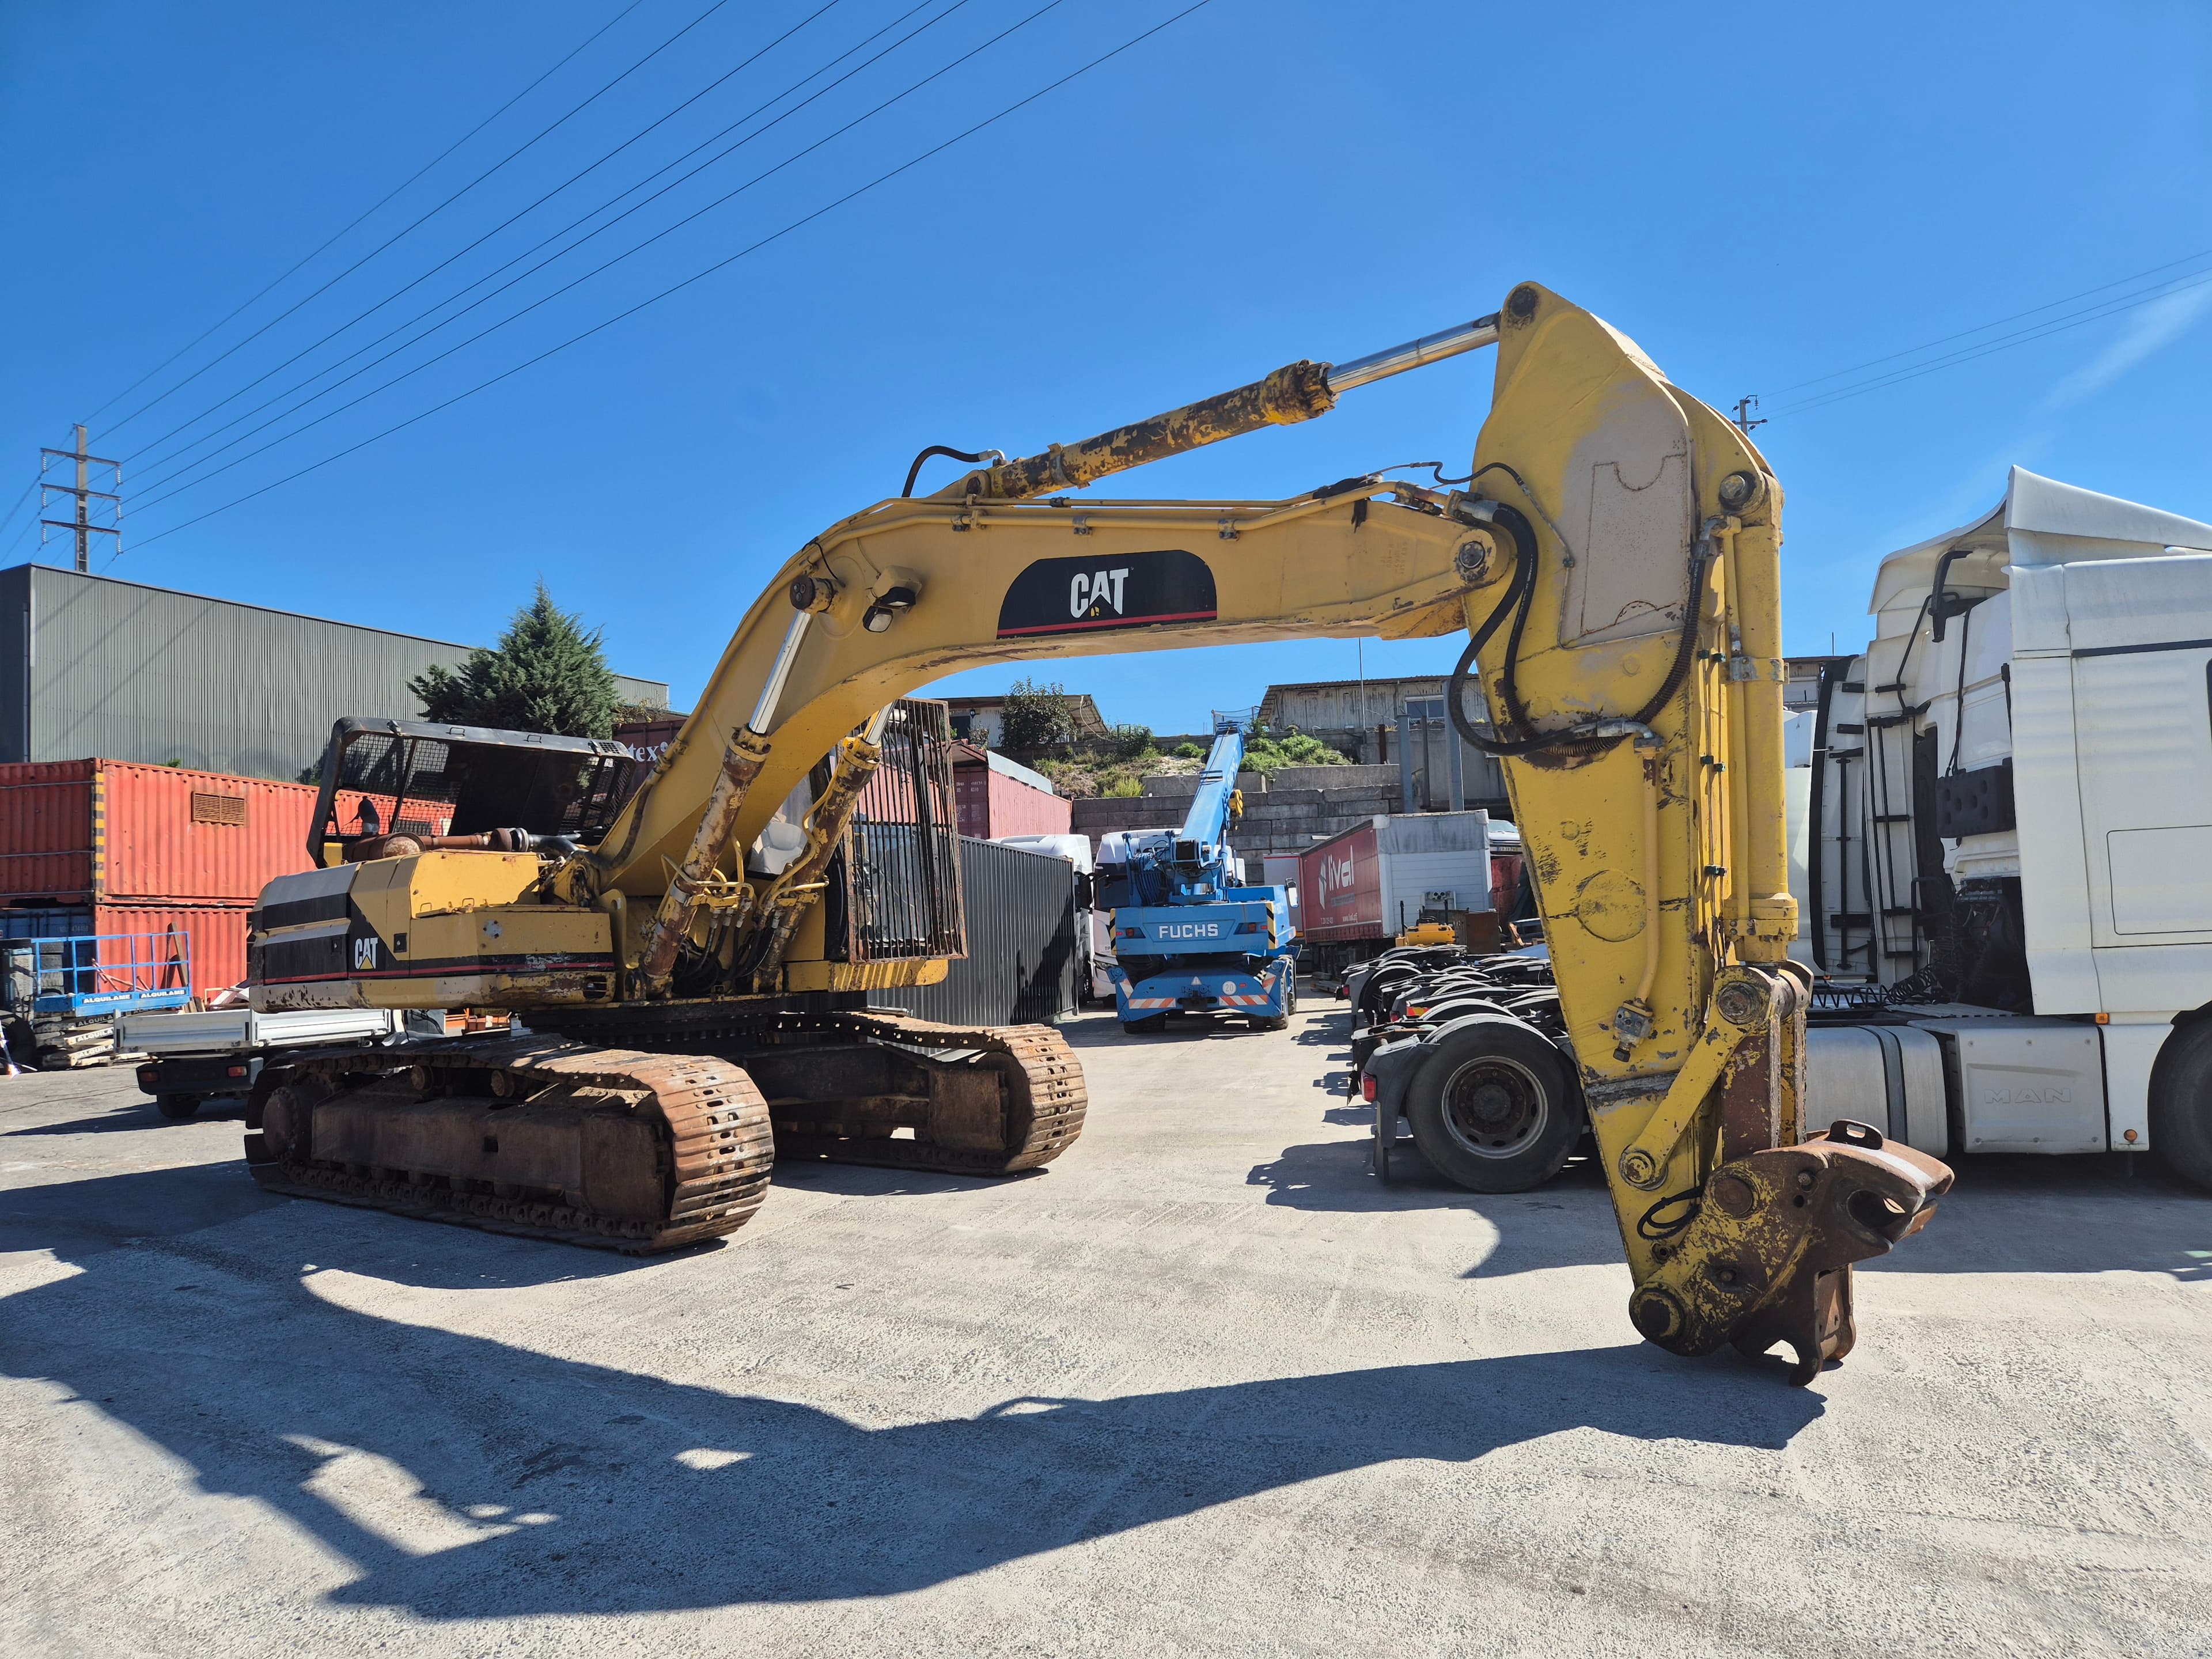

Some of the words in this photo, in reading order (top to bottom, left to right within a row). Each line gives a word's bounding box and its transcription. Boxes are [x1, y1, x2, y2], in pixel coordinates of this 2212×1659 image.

[1070, 568, 1129, 618] CAT
[1328, 844, 1355, 892] lival
[1158, 923, 1219, 939] FUCHS
[355, 937, 378, 969] CAT
[141, 990, 185, 998] ALQUILAME
[1225, 983, 1234, 992] 20
[84, 994, 131, 1003] ALQUILAME
[1984, 1088, 2071, 1104] MAN
